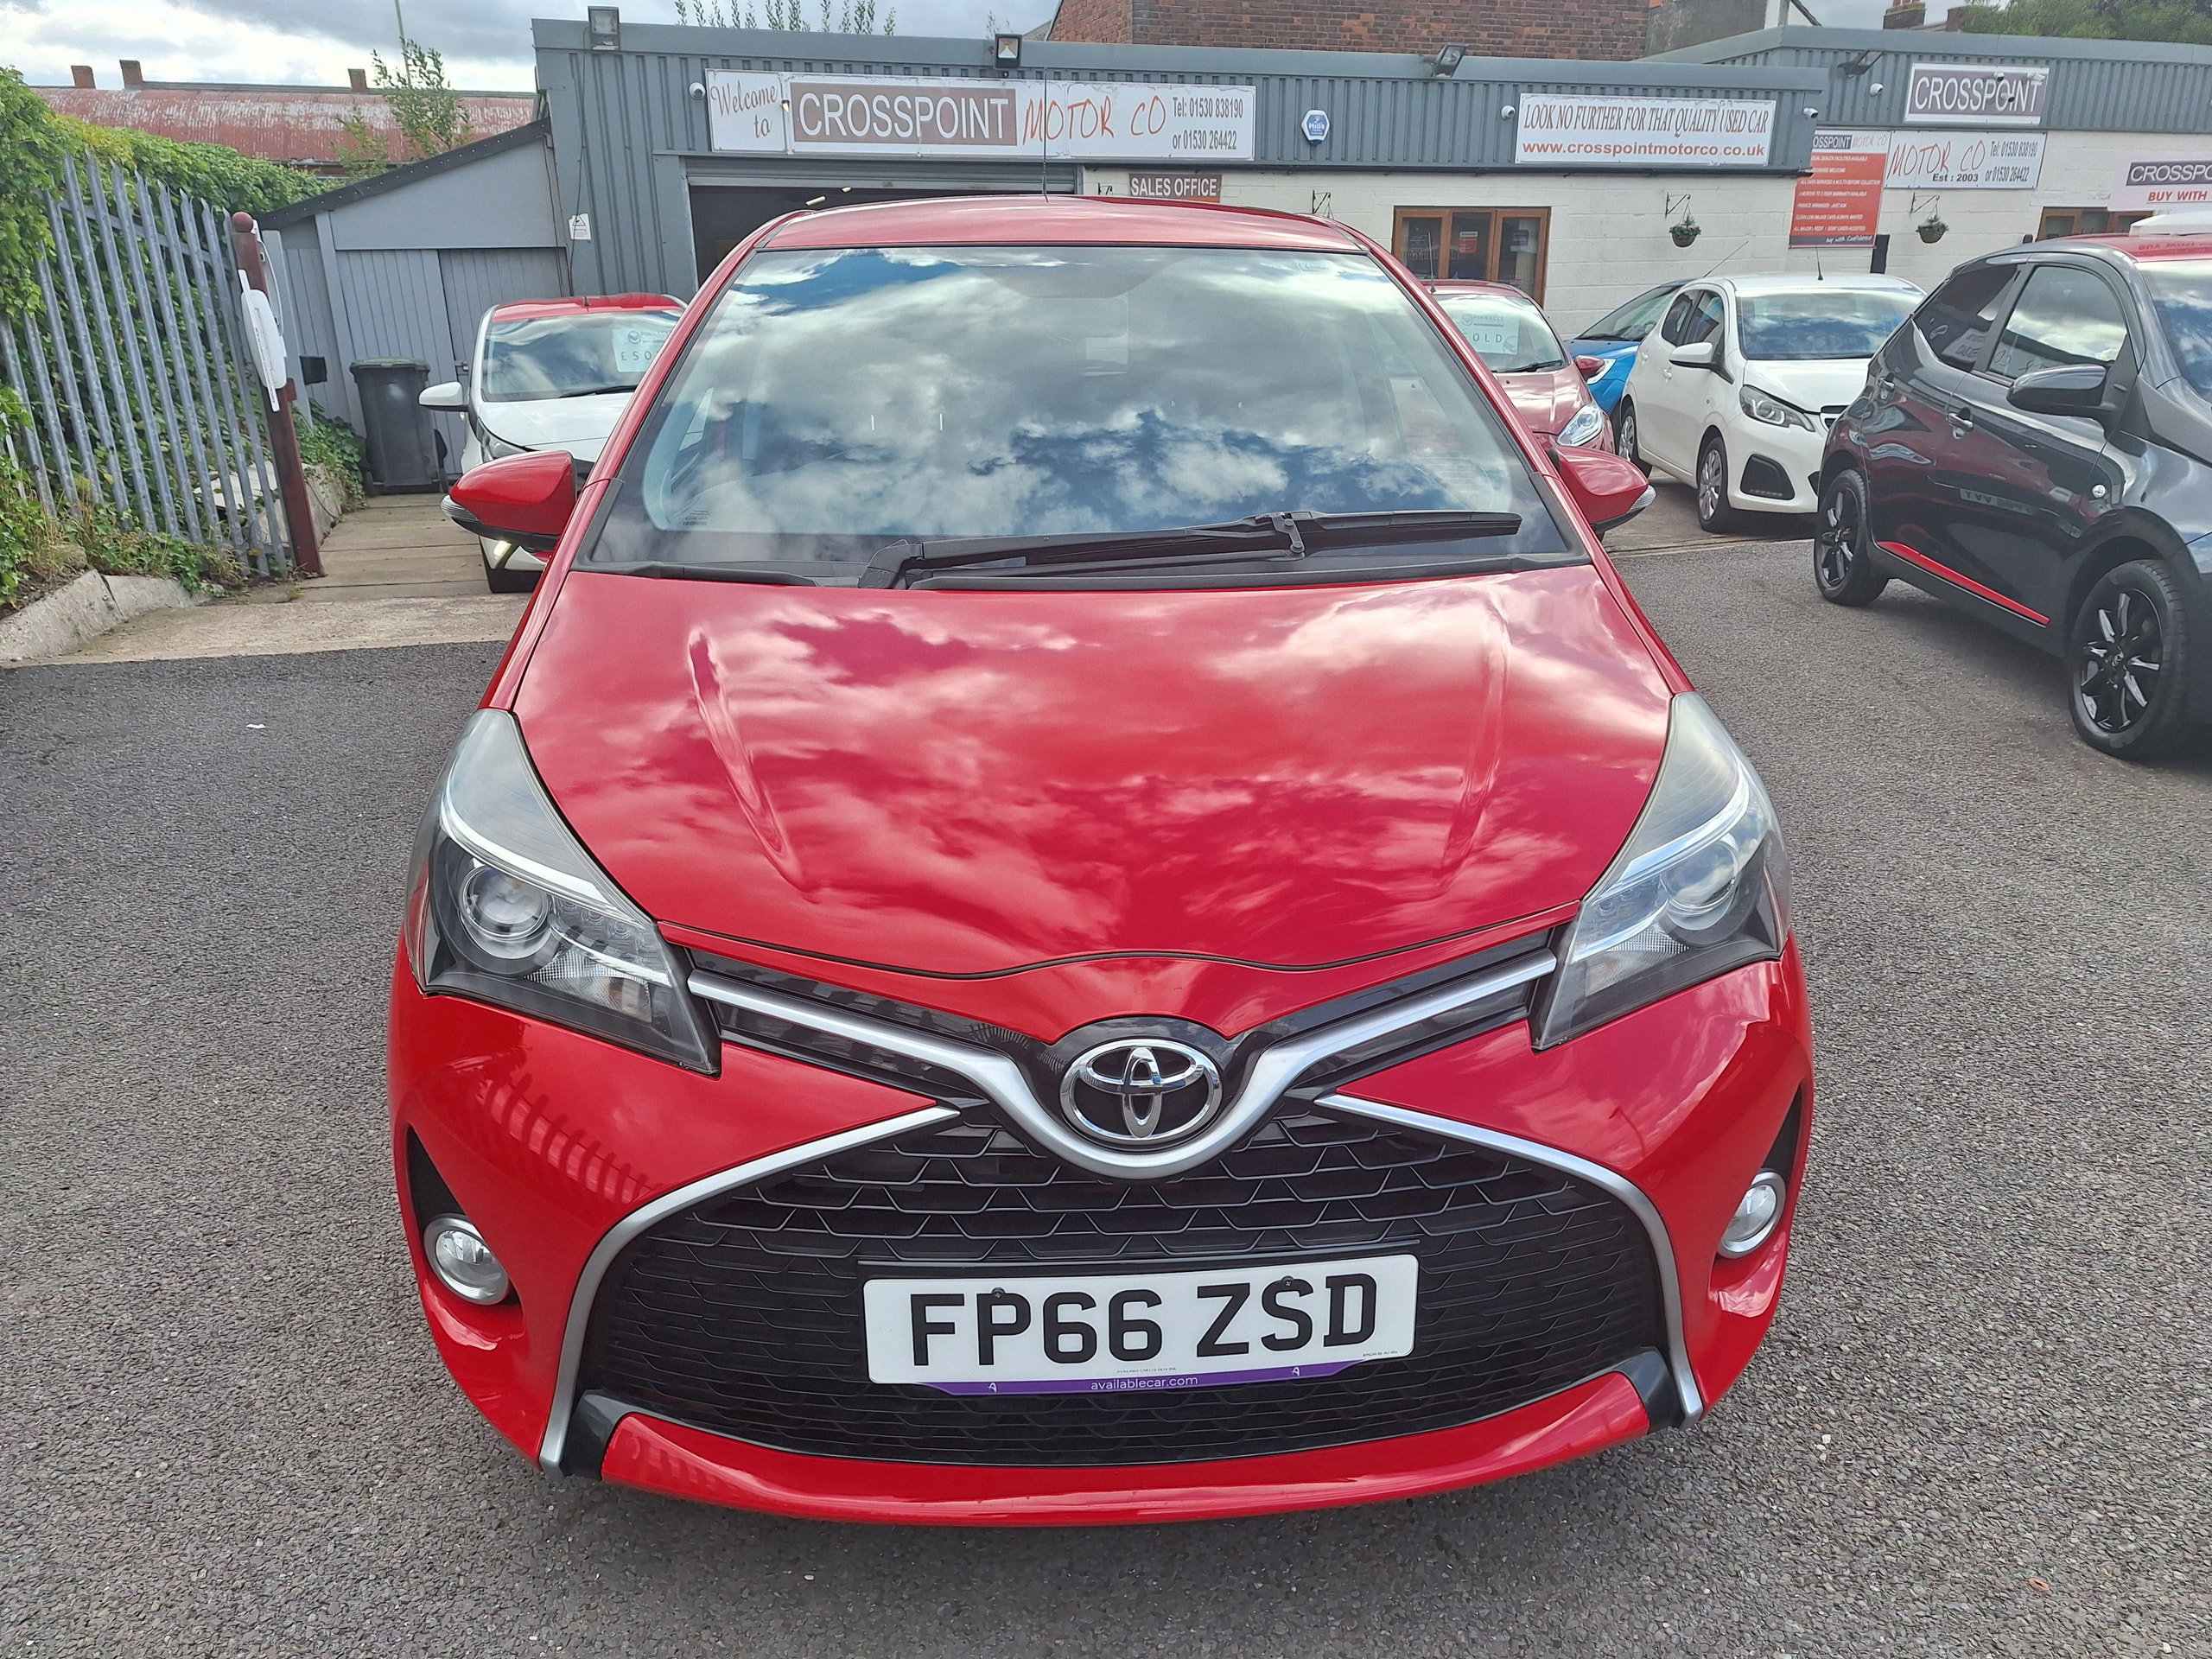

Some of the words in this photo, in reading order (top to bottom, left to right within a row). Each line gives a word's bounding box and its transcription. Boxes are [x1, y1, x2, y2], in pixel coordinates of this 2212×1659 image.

[710, 79, 778, 117] Welcome
[1915, 76, 2043, 112] CROSSPOINT
[798, 92, 1009, 139] CROSSPOINT
[1173, 97, 1187, 118] Tel:
[1189, 97, 1213, 118] 01530
[1215, 98, 1243, 118] 838190
[754, 114, 772, 138] to
[1023, 96, 1115, 145] MOTOR
[1131, 96, 1166, 136] CO
[1523, 104, 1555, 130] LOOK
[1556, 105, 1575, 130] NO
[1574, 105, 1624, 130] FURTHER
[1623, 106, 1647, 130] FOR
[1646, 107, 1676, 132] THAT
[1674, 108, 1721, 137] QUALITY
[1719, 109, 1747, 133] USED
[1748, 110, 1770, 134] CAR
[1173, 134, 1181, 149] or
[1184, 130, 1207, 149] 01530
[1210, 130, 1237, 150] 264422
[1522, 141, 1765, 157] www.crosspointmotorco.co.uk
[1813, 136, 1851, 148] OSSPOINT
[1990, 141, 2001, 157] Tel:
[2001, 141, 2017, 157] 01530
[1886, 140, 1951, 180] MOTOR
[1960, 139, 1986, 171] CO
[1956, 174, 1978, 182] 2003
[1985, 169, 1992, 181] or
[1992, 167, 2009, 181] 01530
[1131, 177, 1171, 196] SALES
[1174, 178, 1217, 196] OFFICE
[2148, 191, 2173, 201] BUY
[2177, 190, 2208, 200] WITH
[1464, 333, 1503, 343] OLD
[910, 1289, 1163, 1366] FP66
[1196, 1273, 1378, 1357] ZSD
[1090, 1376, 1198, 1390] availablecar.com
